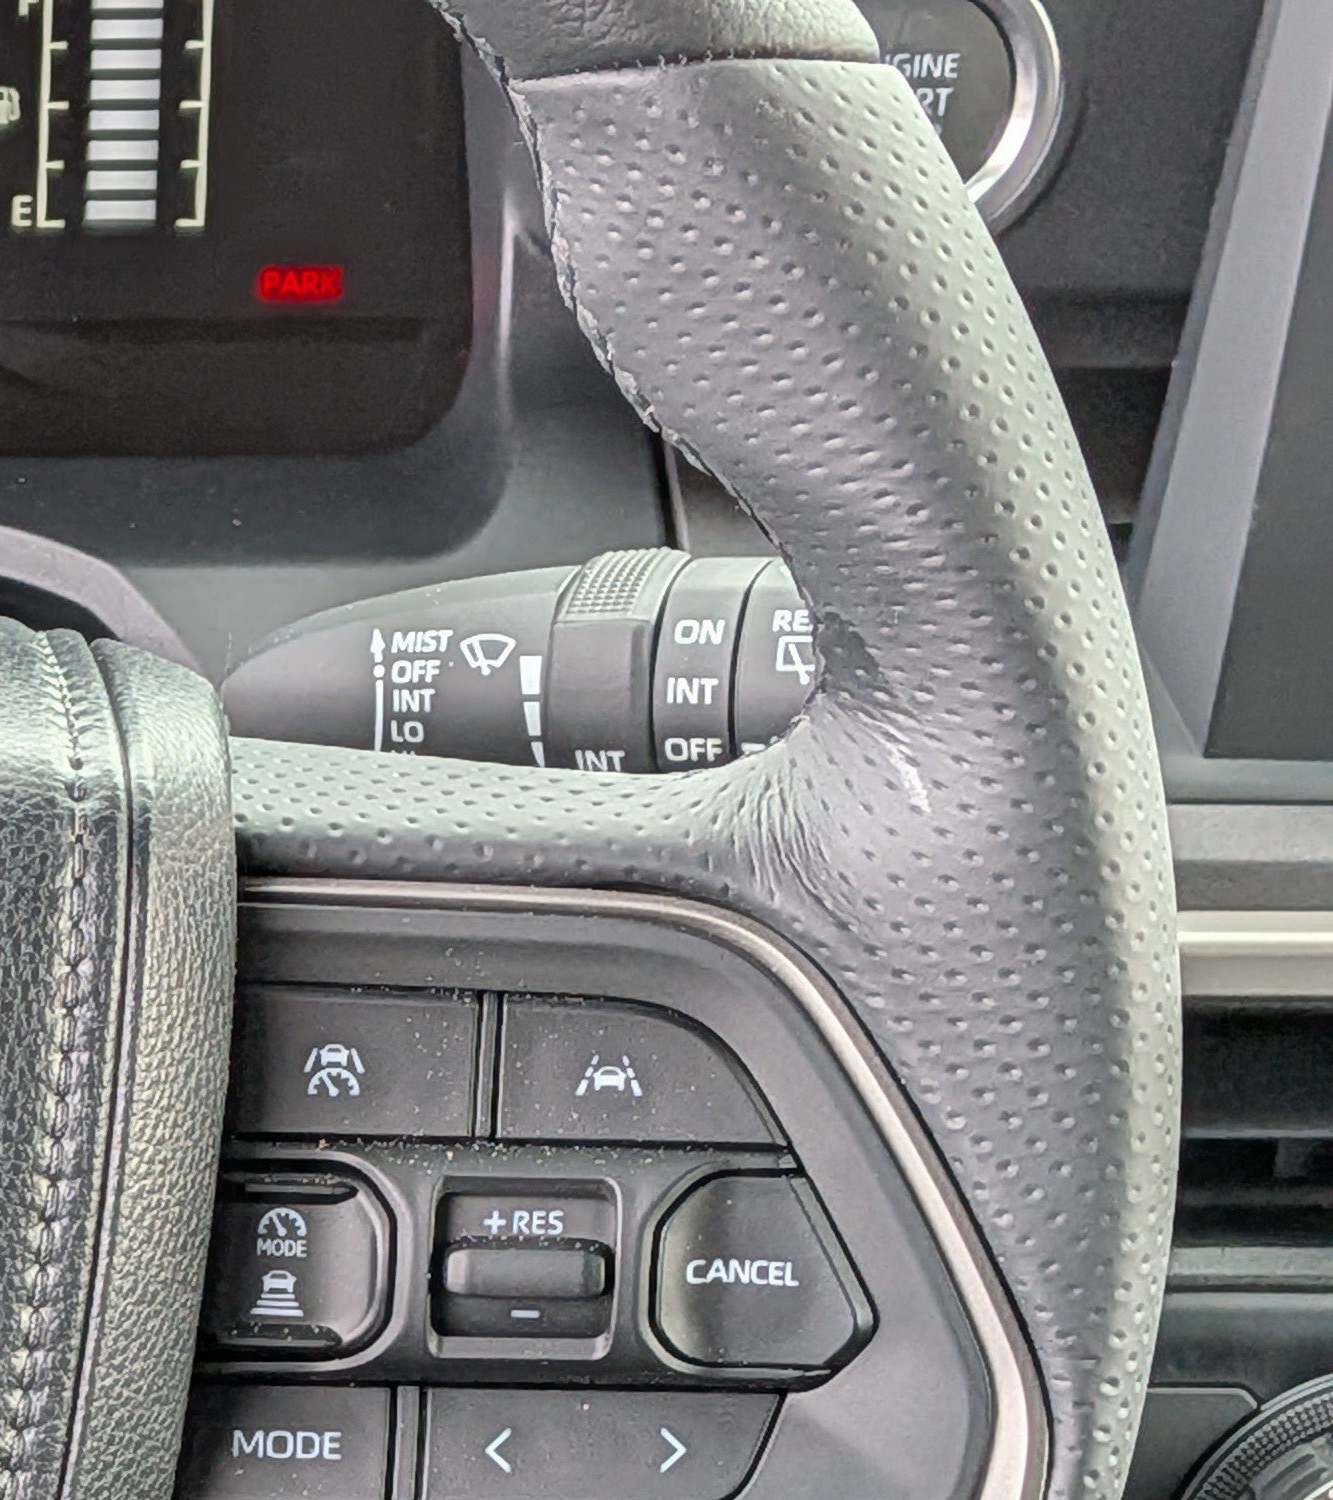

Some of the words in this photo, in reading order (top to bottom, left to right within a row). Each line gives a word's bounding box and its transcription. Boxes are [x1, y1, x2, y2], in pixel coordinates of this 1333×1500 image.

[884, 52, 961, 79] GINE
[12, 195, 33, 227] E
[260, 267, 343, 298] PARK
[674, 619, 726, 645] ON
[772, 609, 813, 632] RE
[391, 629, 454, 653] MIST
[391, 659, 441, 684] OFF
[392, 688, 435, 713] INT
[666, 677, 719, 705] INT
[390, 719, 424, 743] LO
[574, 750, 626, 772] INT
[664, 737, 723, 762] OFF
[256, 1237, 308, 1257] MODE
[686, 1258, 799, 1287] CANCEL
[232, 1429, 342, 1459] MODE
